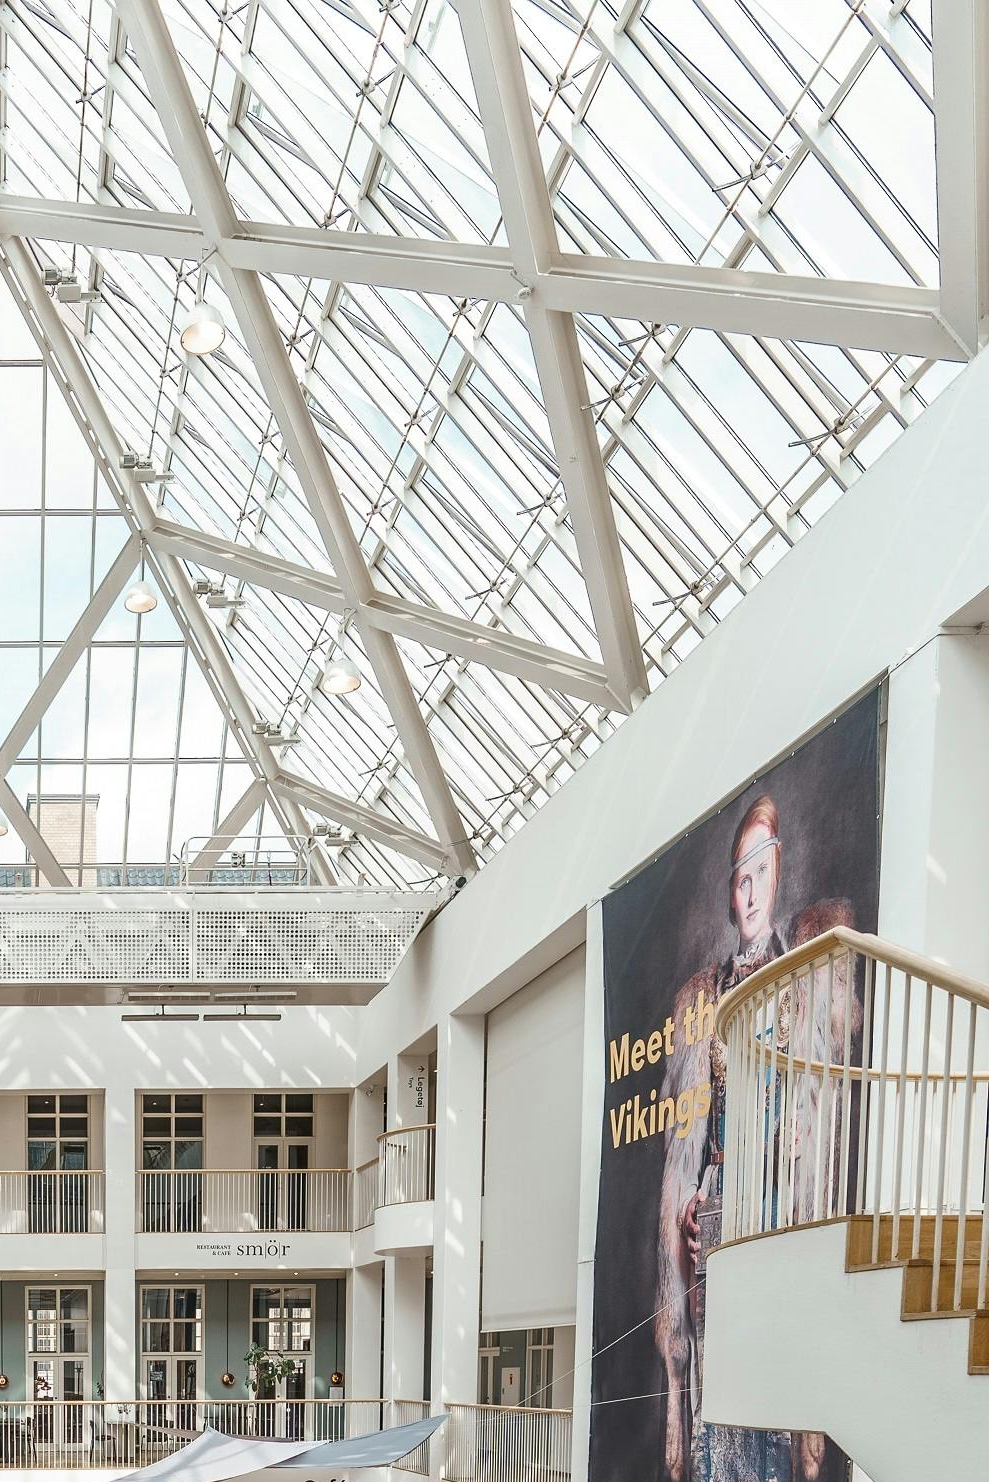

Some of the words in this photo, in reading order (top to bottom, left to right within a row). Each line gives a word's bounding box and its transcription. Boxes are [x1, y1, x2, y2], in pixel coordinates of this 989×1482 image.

[609, 1016, 675, 1084] Meet
[684, 989, 714, 1047] th
[416, 1077, 425, 1108] Legetøj
[610, 1082, 711, 1149] Vikings
